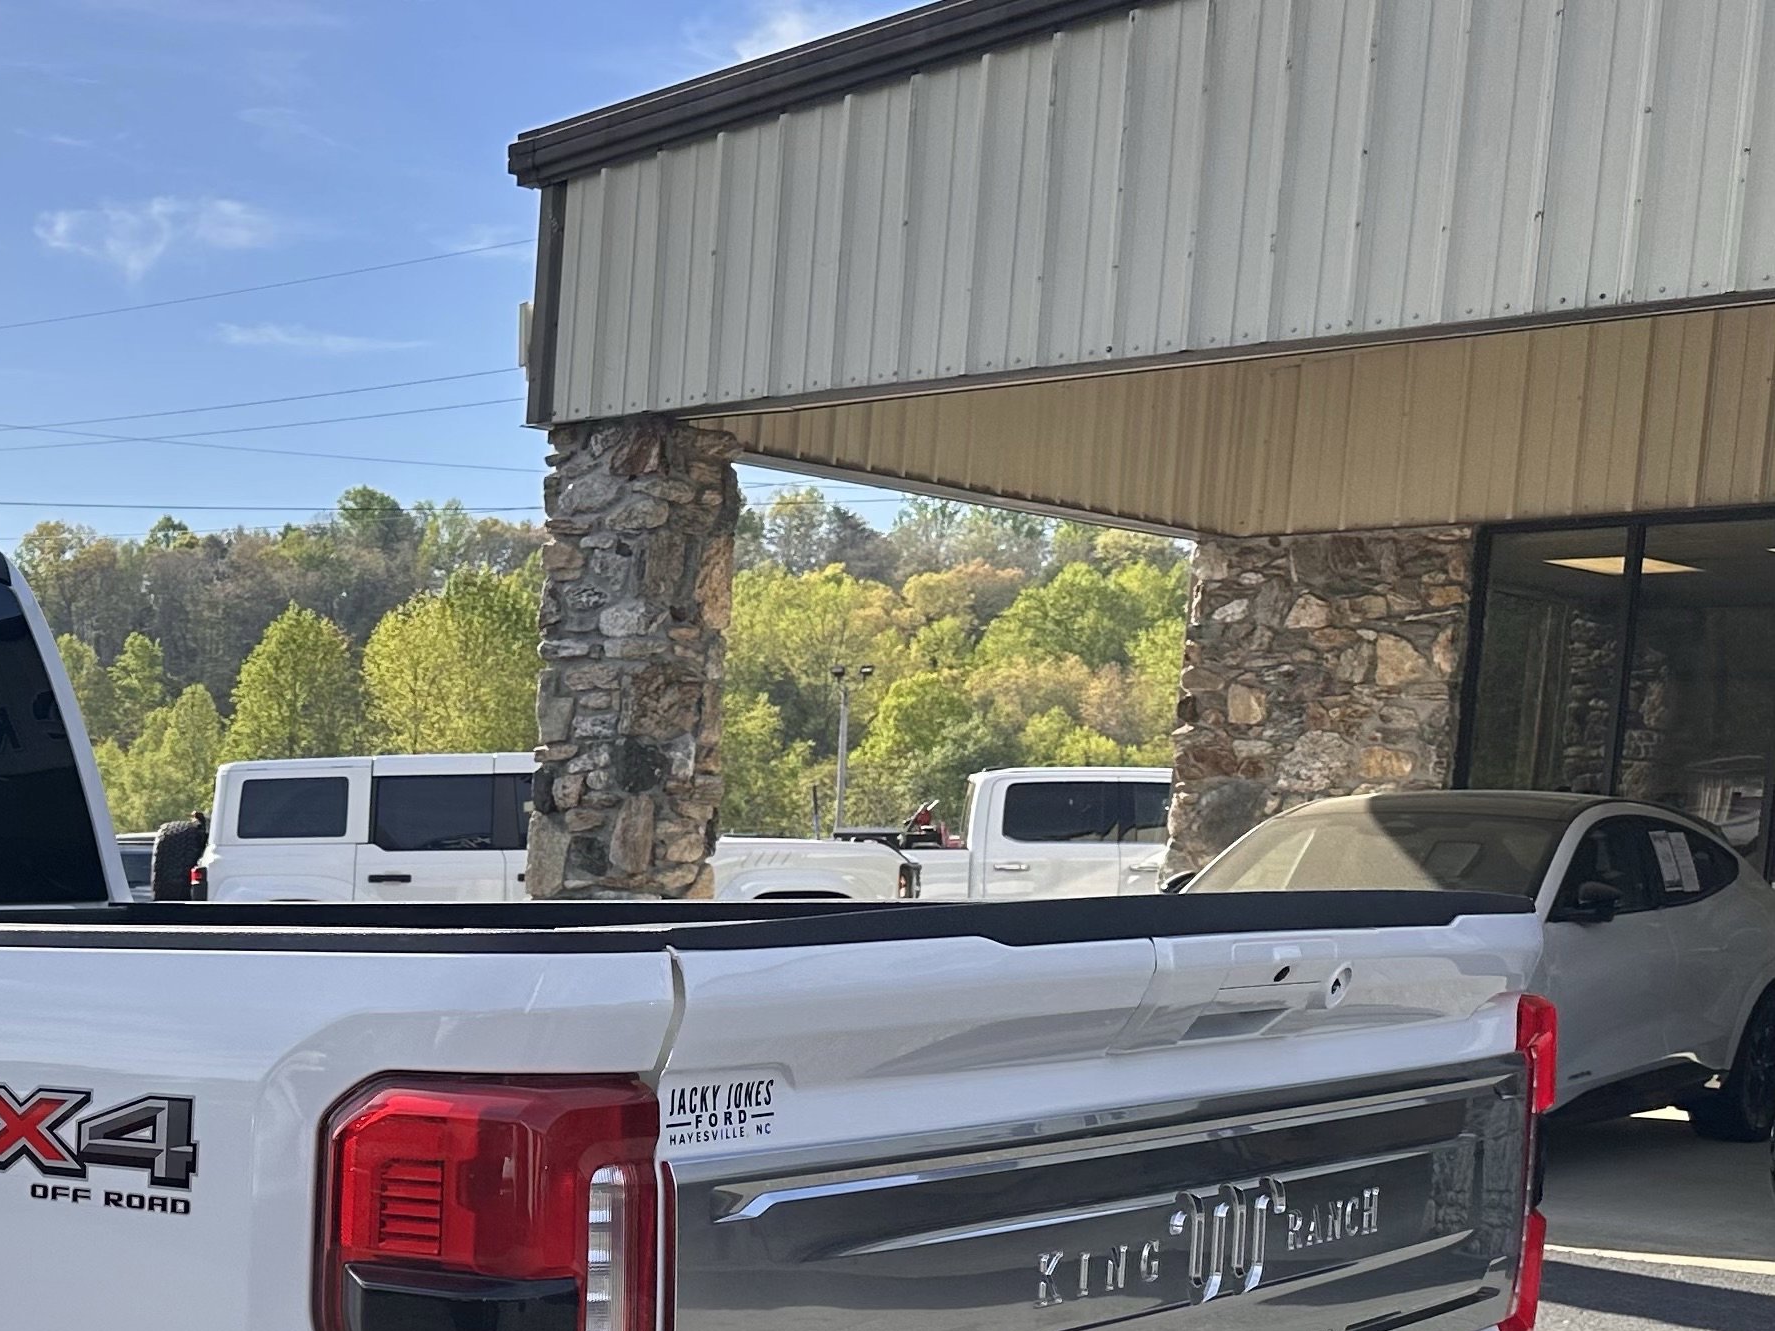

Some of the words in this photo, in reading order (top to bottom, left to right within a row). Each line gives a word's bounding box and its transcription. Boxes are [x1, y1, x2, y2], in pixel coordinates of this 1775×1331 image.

[669, 1084, 722, 1116] JACKY
[726, 1079, 774, 1110] JONES
[695, 1110, 747, 1129] FORD
[756, 1123, 772, 1136] NC
[30, 1183, 91, 1203] OFF
[103, 1190, 191, 1215] ROAD
[1033, 1240, 1160, 1309] KING
[1287, 1186, 1380, 1251] RANCH
